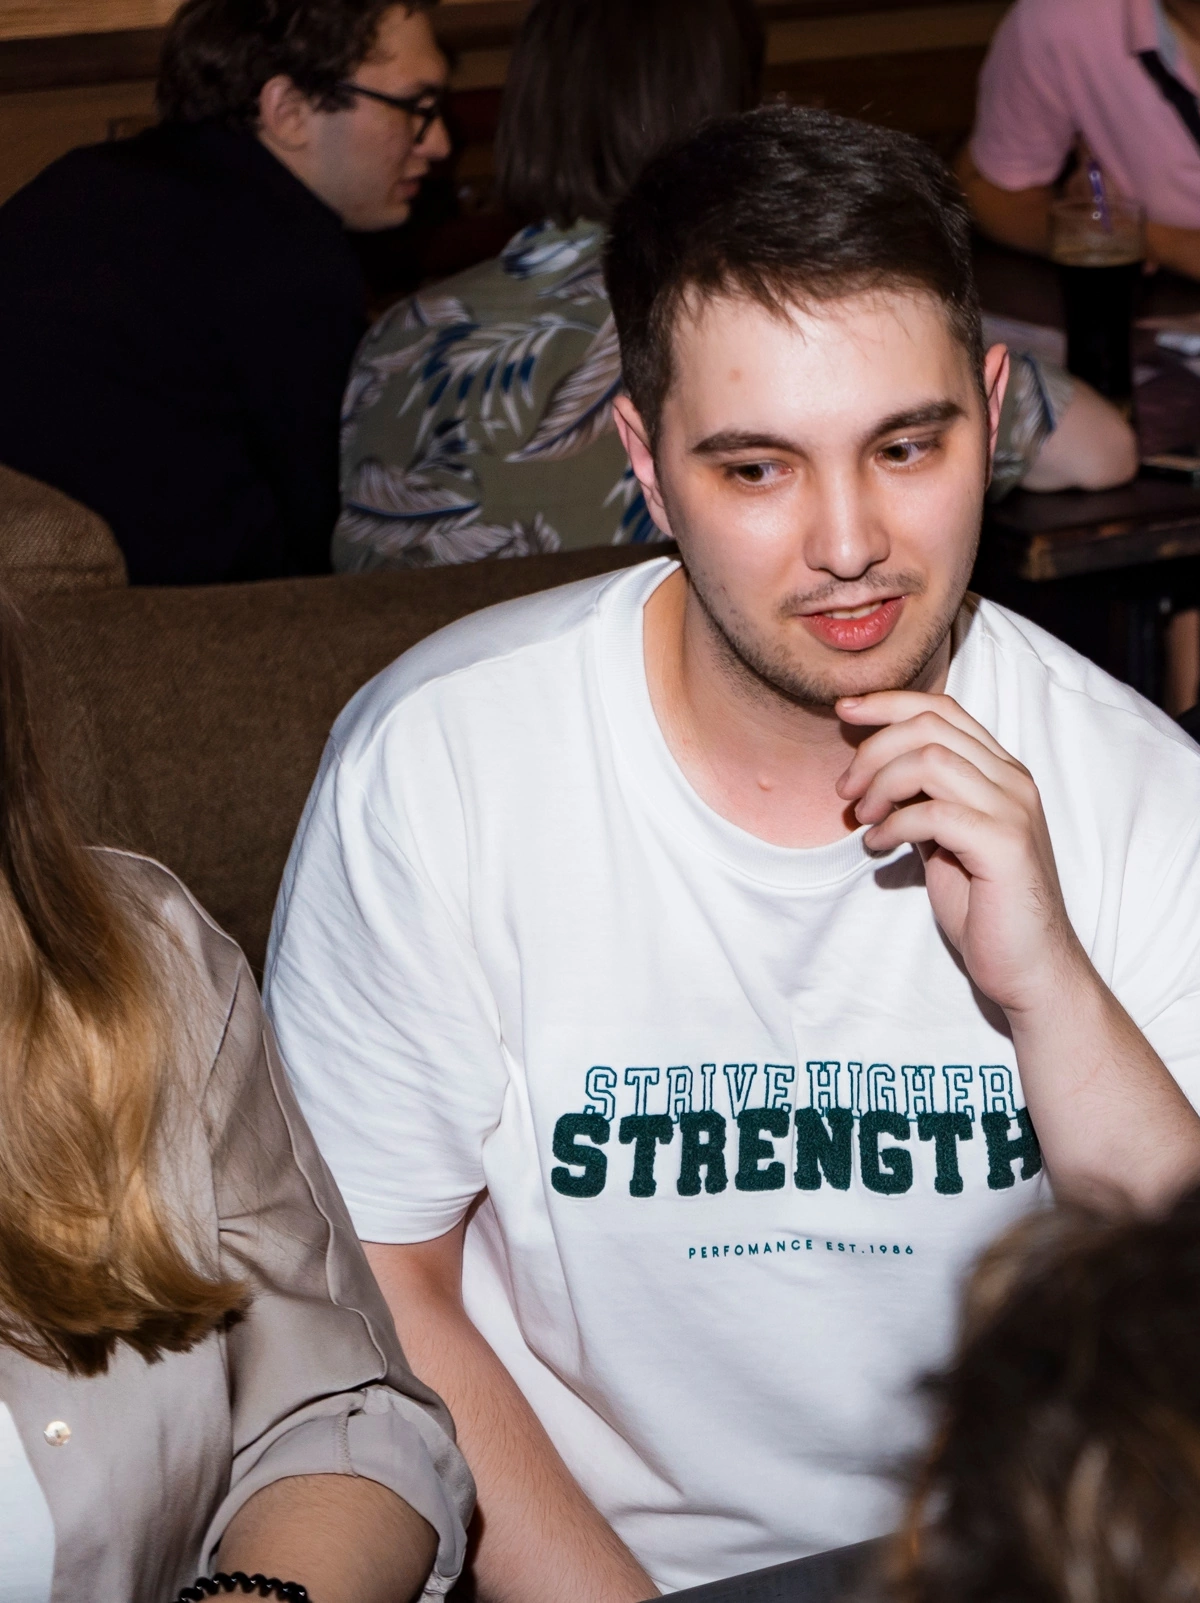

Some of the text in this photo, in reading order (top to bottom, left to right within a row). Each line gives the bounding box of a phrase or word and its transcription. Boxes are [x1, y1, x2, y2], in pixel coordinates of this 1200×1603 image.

[583, 1061, 1019, 1123] STRIVE HIGHER
[550, 1106, 1042, 1198] STRENGTH
[687, 1238, 814, 1260] PERFOMANCE
